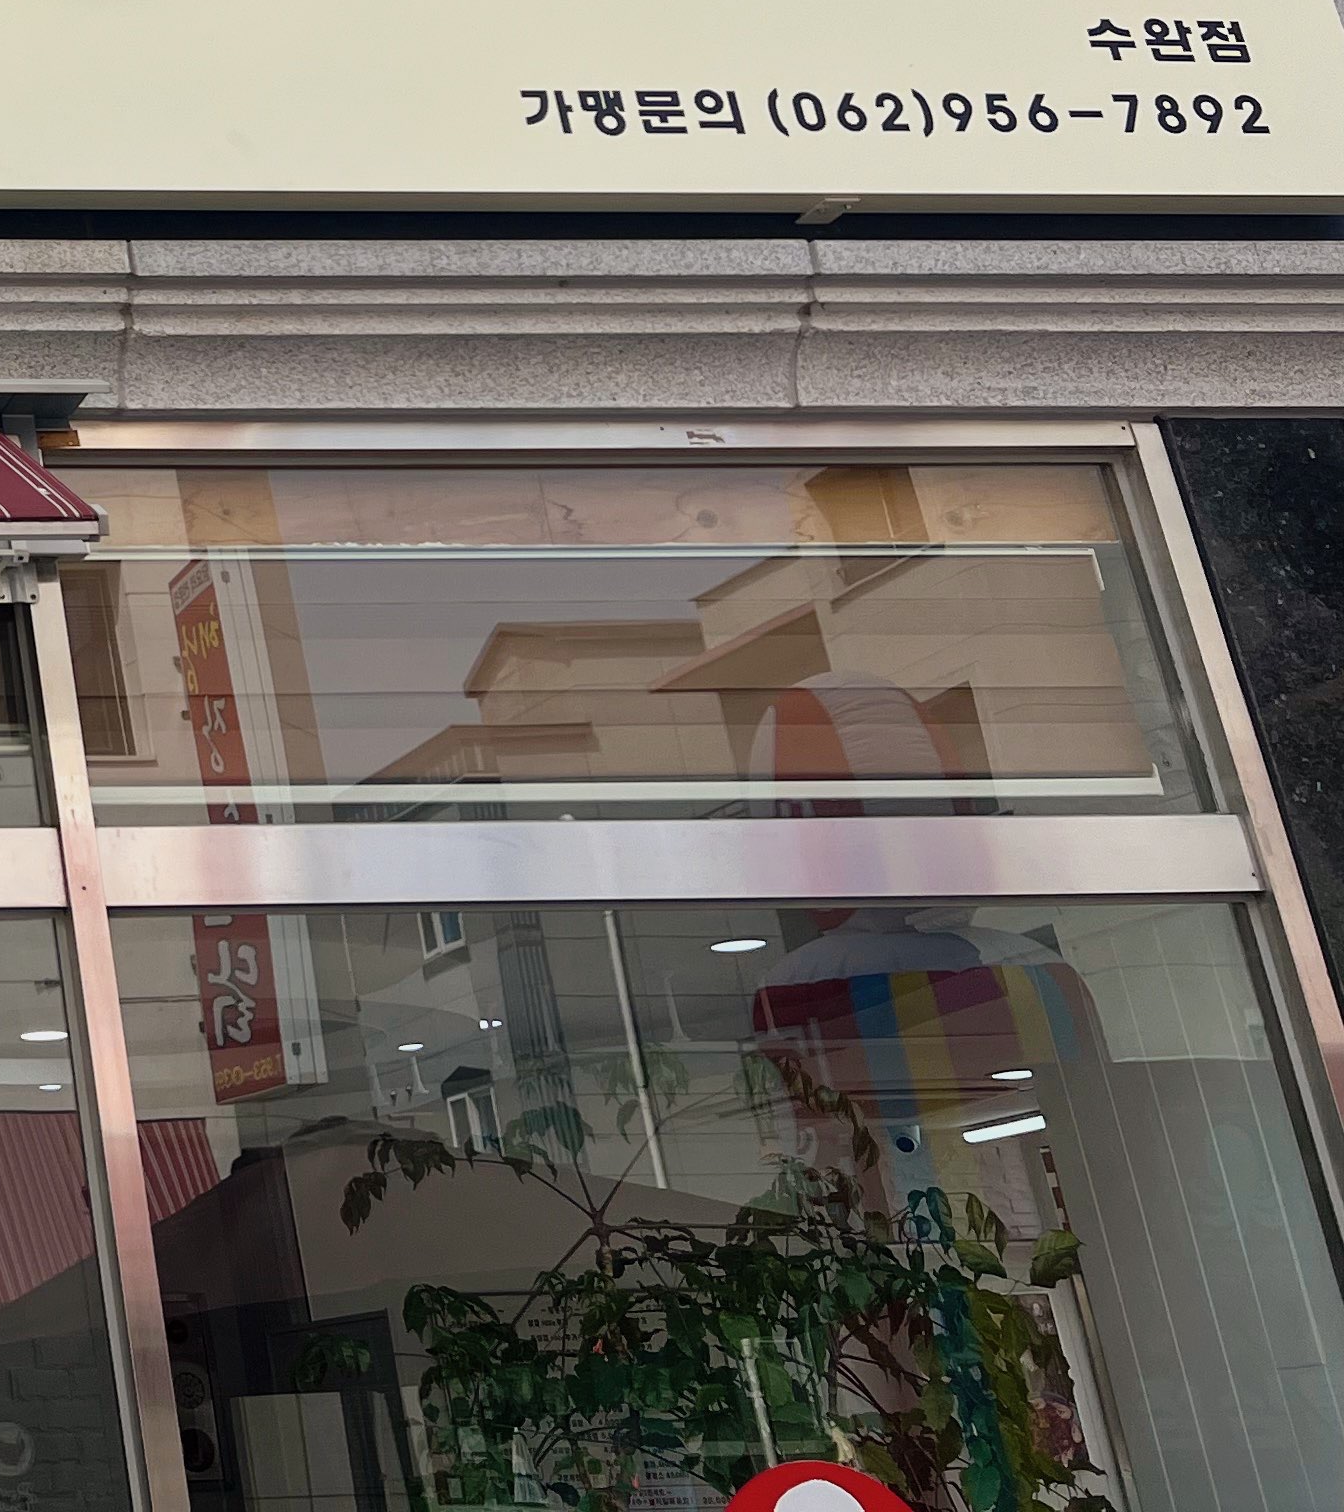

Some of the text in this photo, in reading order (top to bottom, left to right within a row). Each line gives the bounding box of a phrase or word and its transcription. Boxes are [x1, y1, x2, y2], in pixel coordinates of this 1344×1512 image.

[1085, 17, 1252, 65] 수완점
[519, 88, 1272, 137] 가맹문의 (062)956-7892
